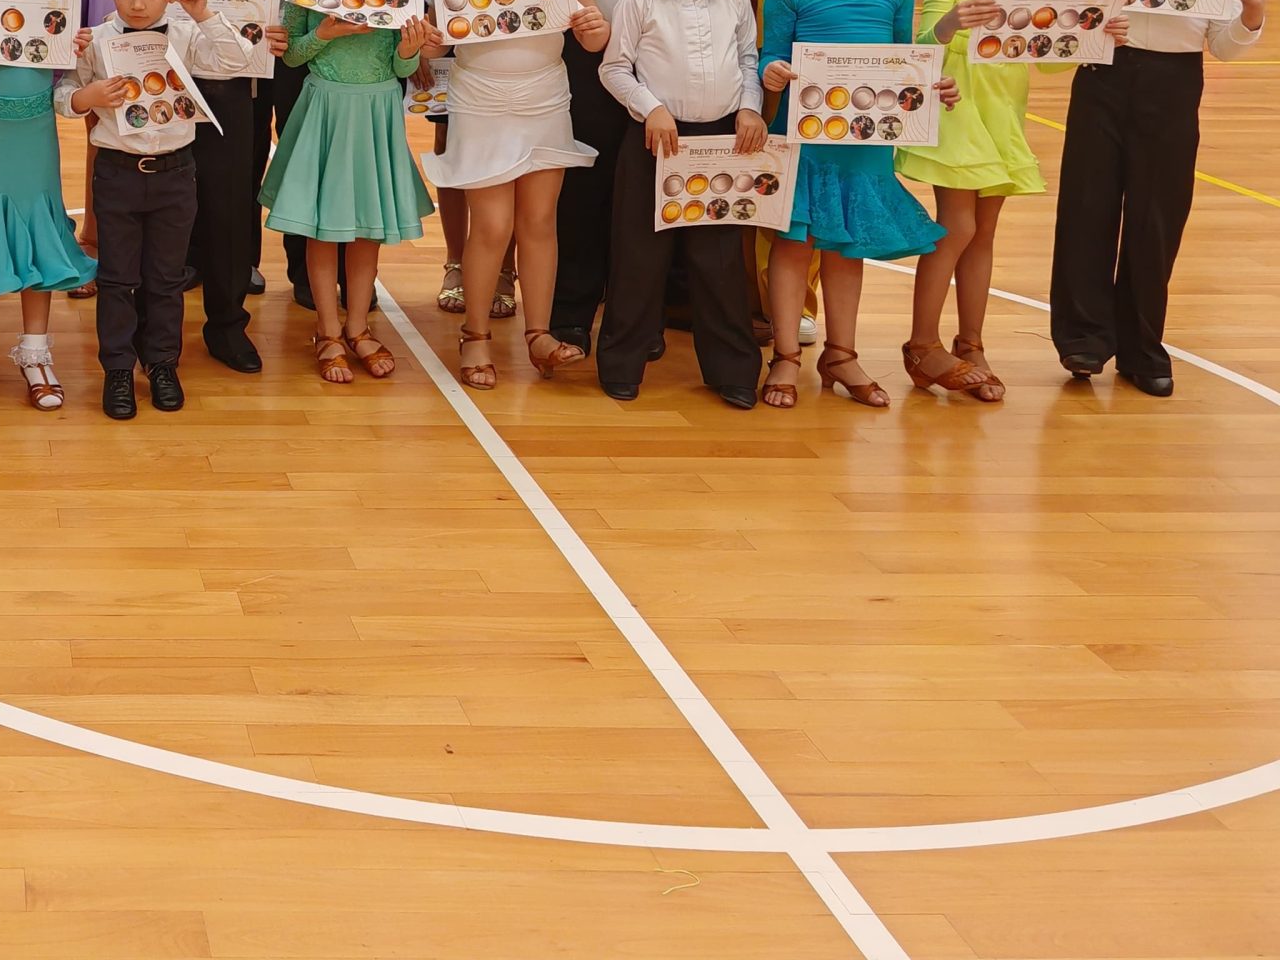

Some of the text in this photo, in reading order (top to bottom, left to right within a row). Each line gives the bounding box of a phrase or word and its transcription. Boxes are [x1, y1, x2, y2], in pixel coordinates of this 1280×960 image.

[826, 56, 870, 65] BREVETTO
[871, 57, 881, 65] DI
[689, 148, 731, 156] BREVETTO
